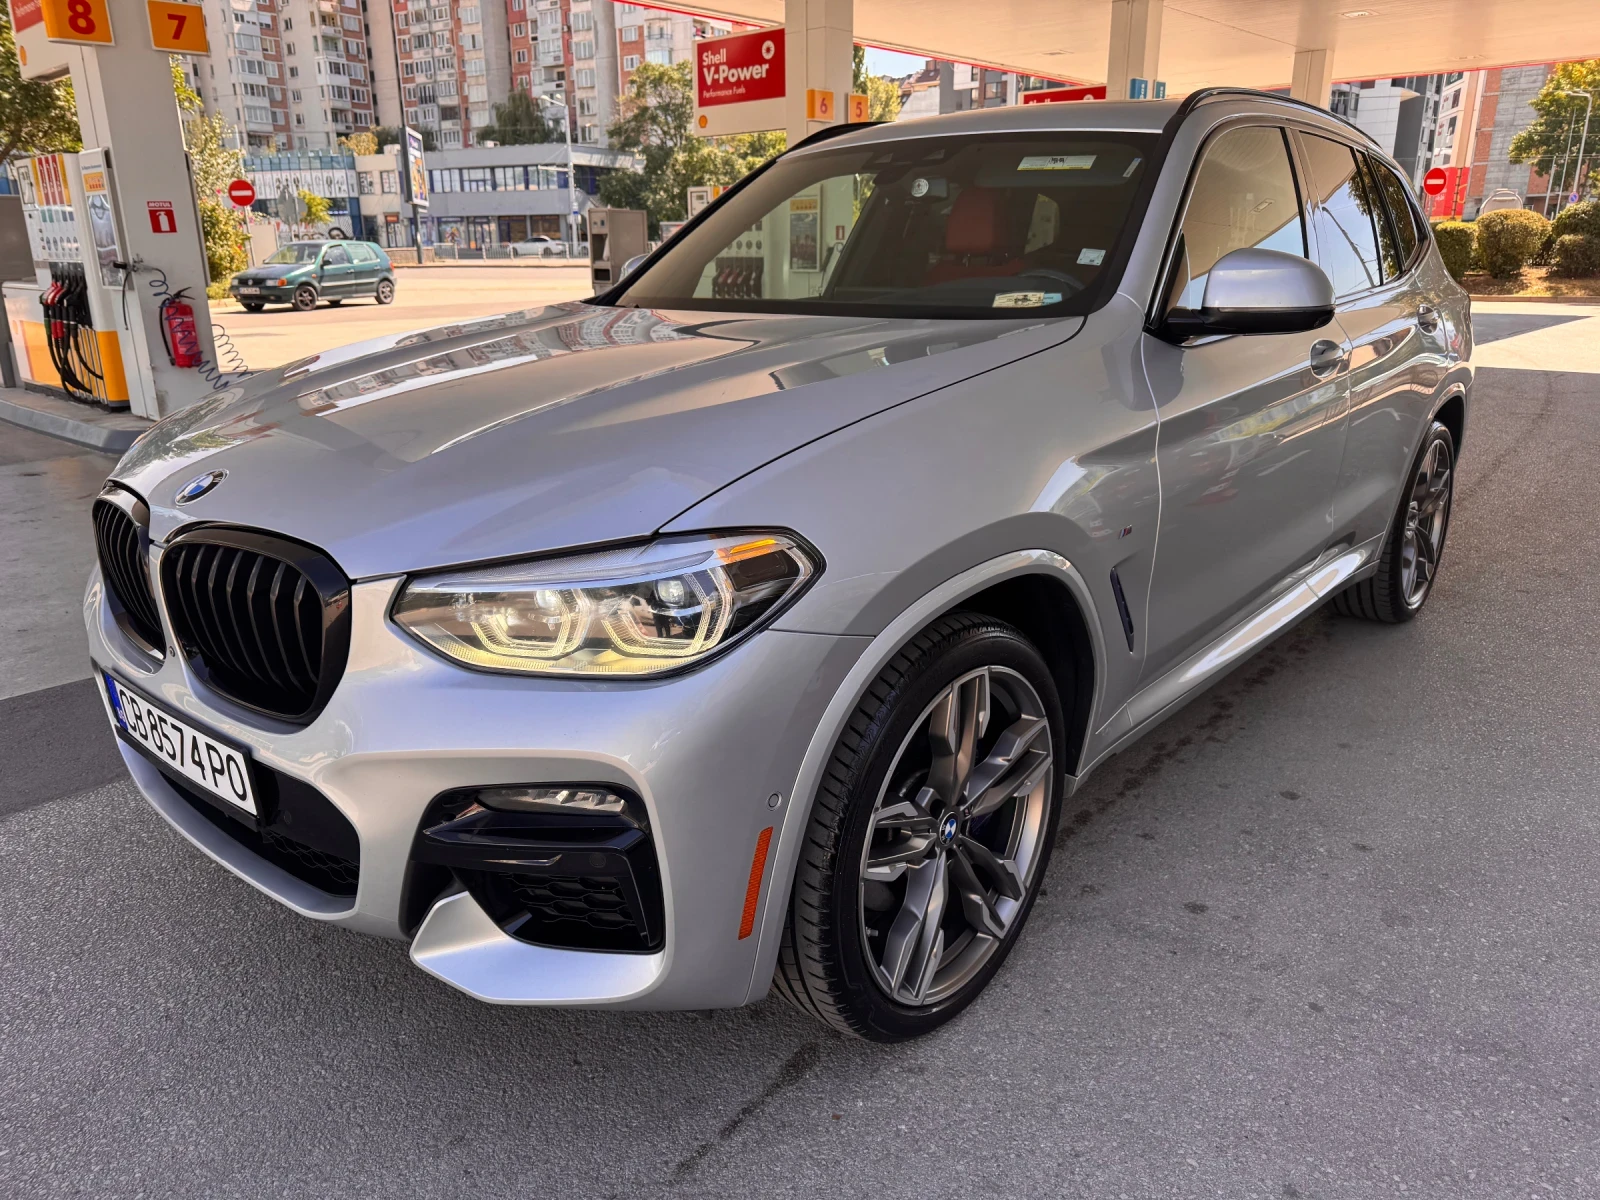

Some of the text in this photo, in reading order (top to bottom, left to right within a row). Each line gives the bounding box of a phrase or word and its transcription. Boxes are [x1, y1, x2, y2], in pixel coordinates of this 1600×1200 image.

[67, 0, 96, 35] 8
[167, 13, 187, 40] 7
[702, 48, 726, 66] Shell
[703, 63, 769, 86] V-Power
[703, 84, 746, 99] Performance Fuels
[820, 97, 828, 114] 6
[855, 101, 863, 118] 5
